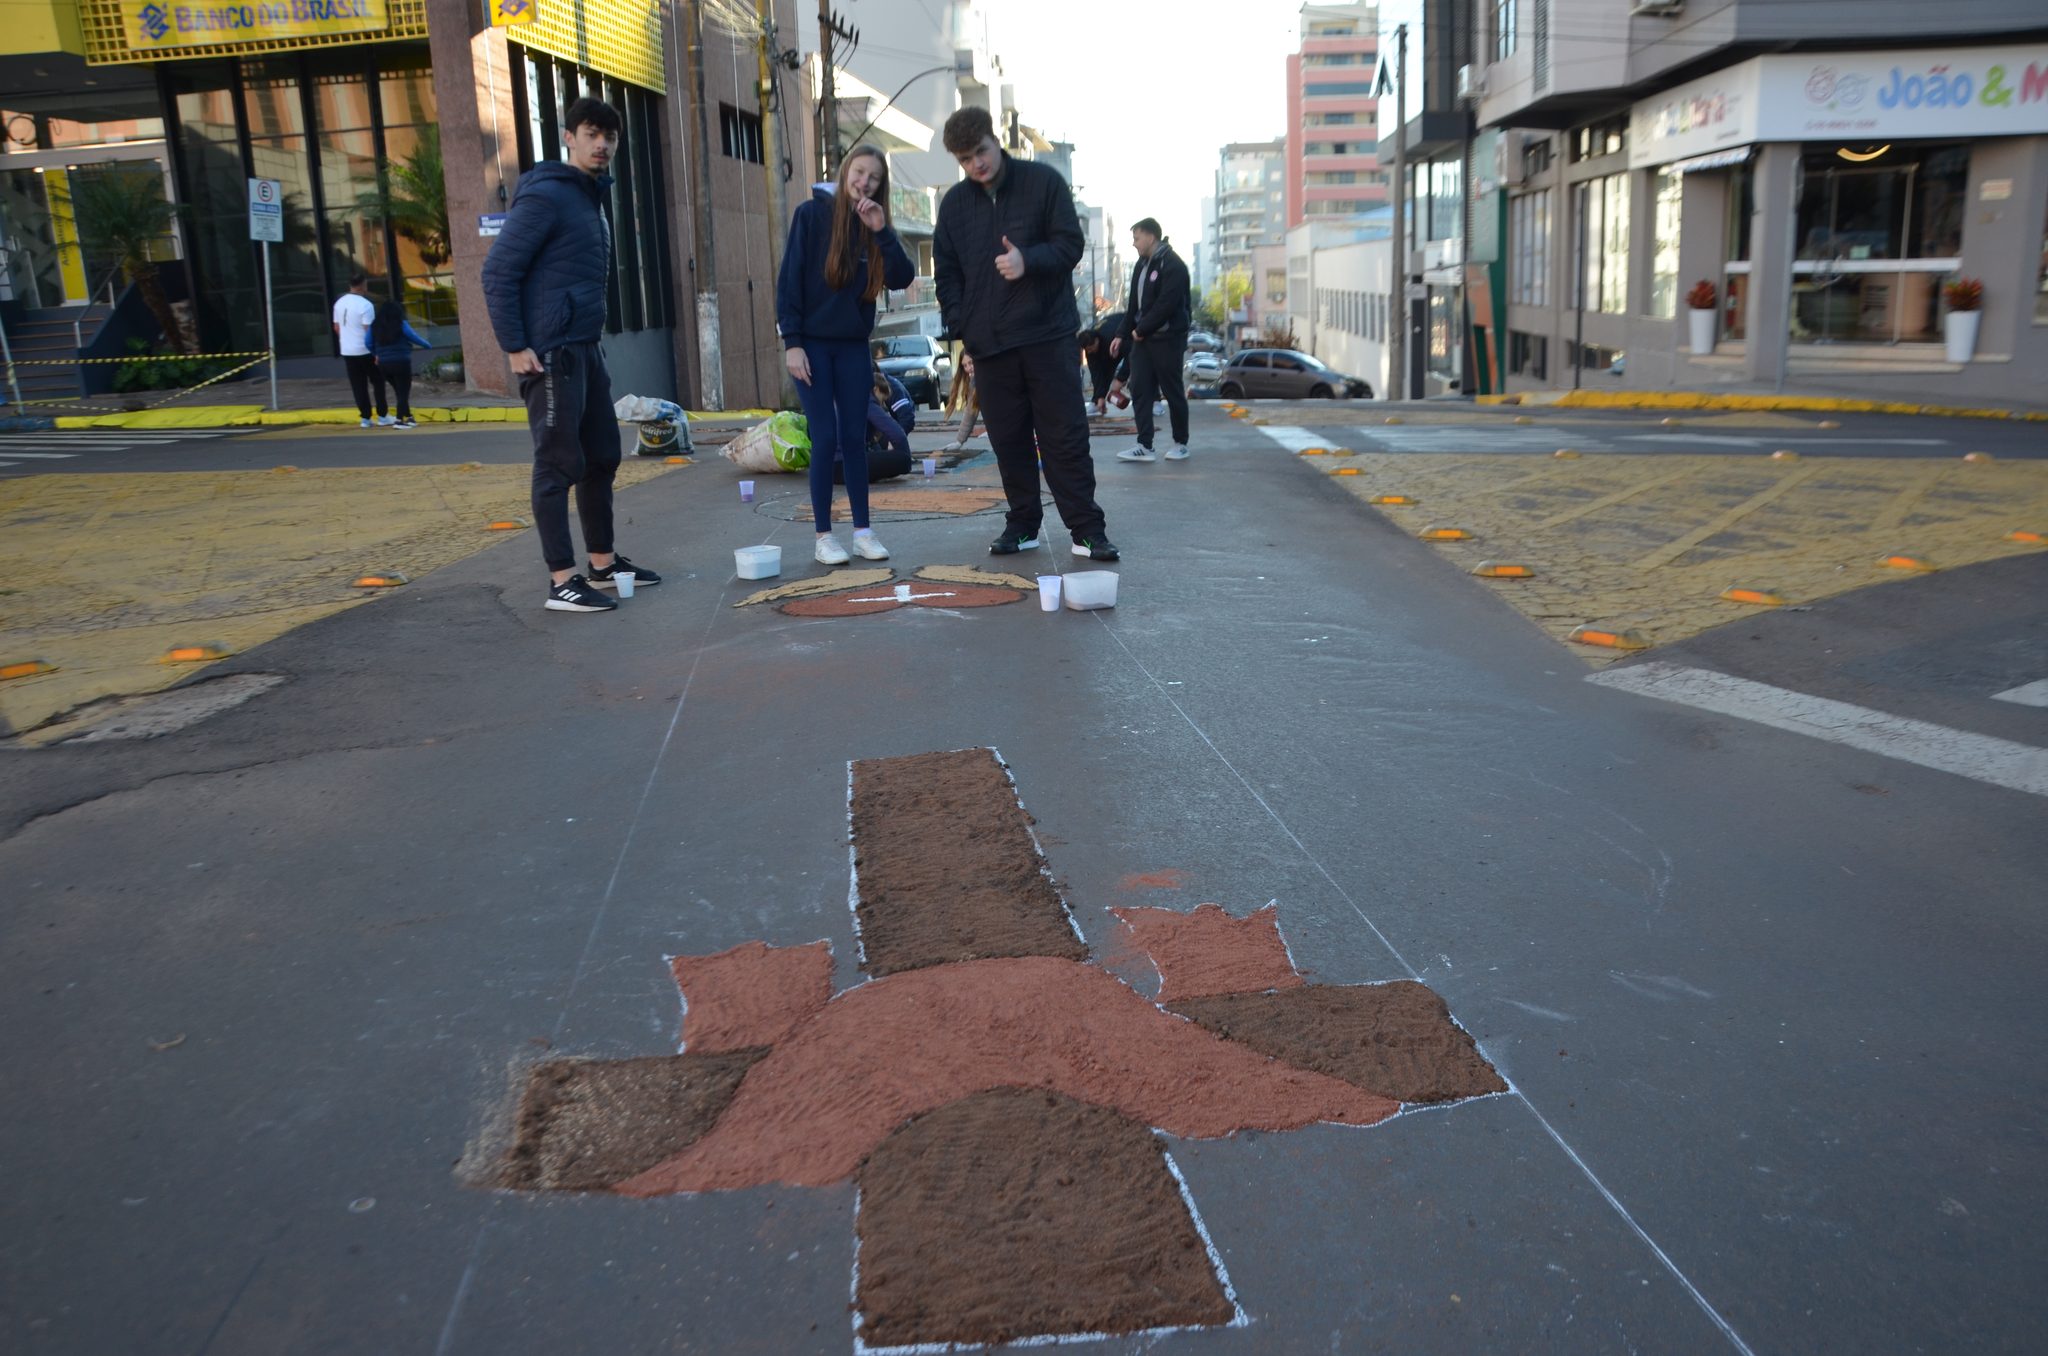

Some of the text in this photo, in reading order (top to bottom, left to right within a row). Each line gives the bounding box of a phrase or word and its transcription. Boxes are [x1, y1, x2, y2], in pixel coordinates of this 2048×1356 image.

[174, 0, 373, 33] BANCO DO BRASIL
[1879, 65, 1972, 109] João
[1980, 64, 2014, 108] &
[261, 185, 270, 198] E
